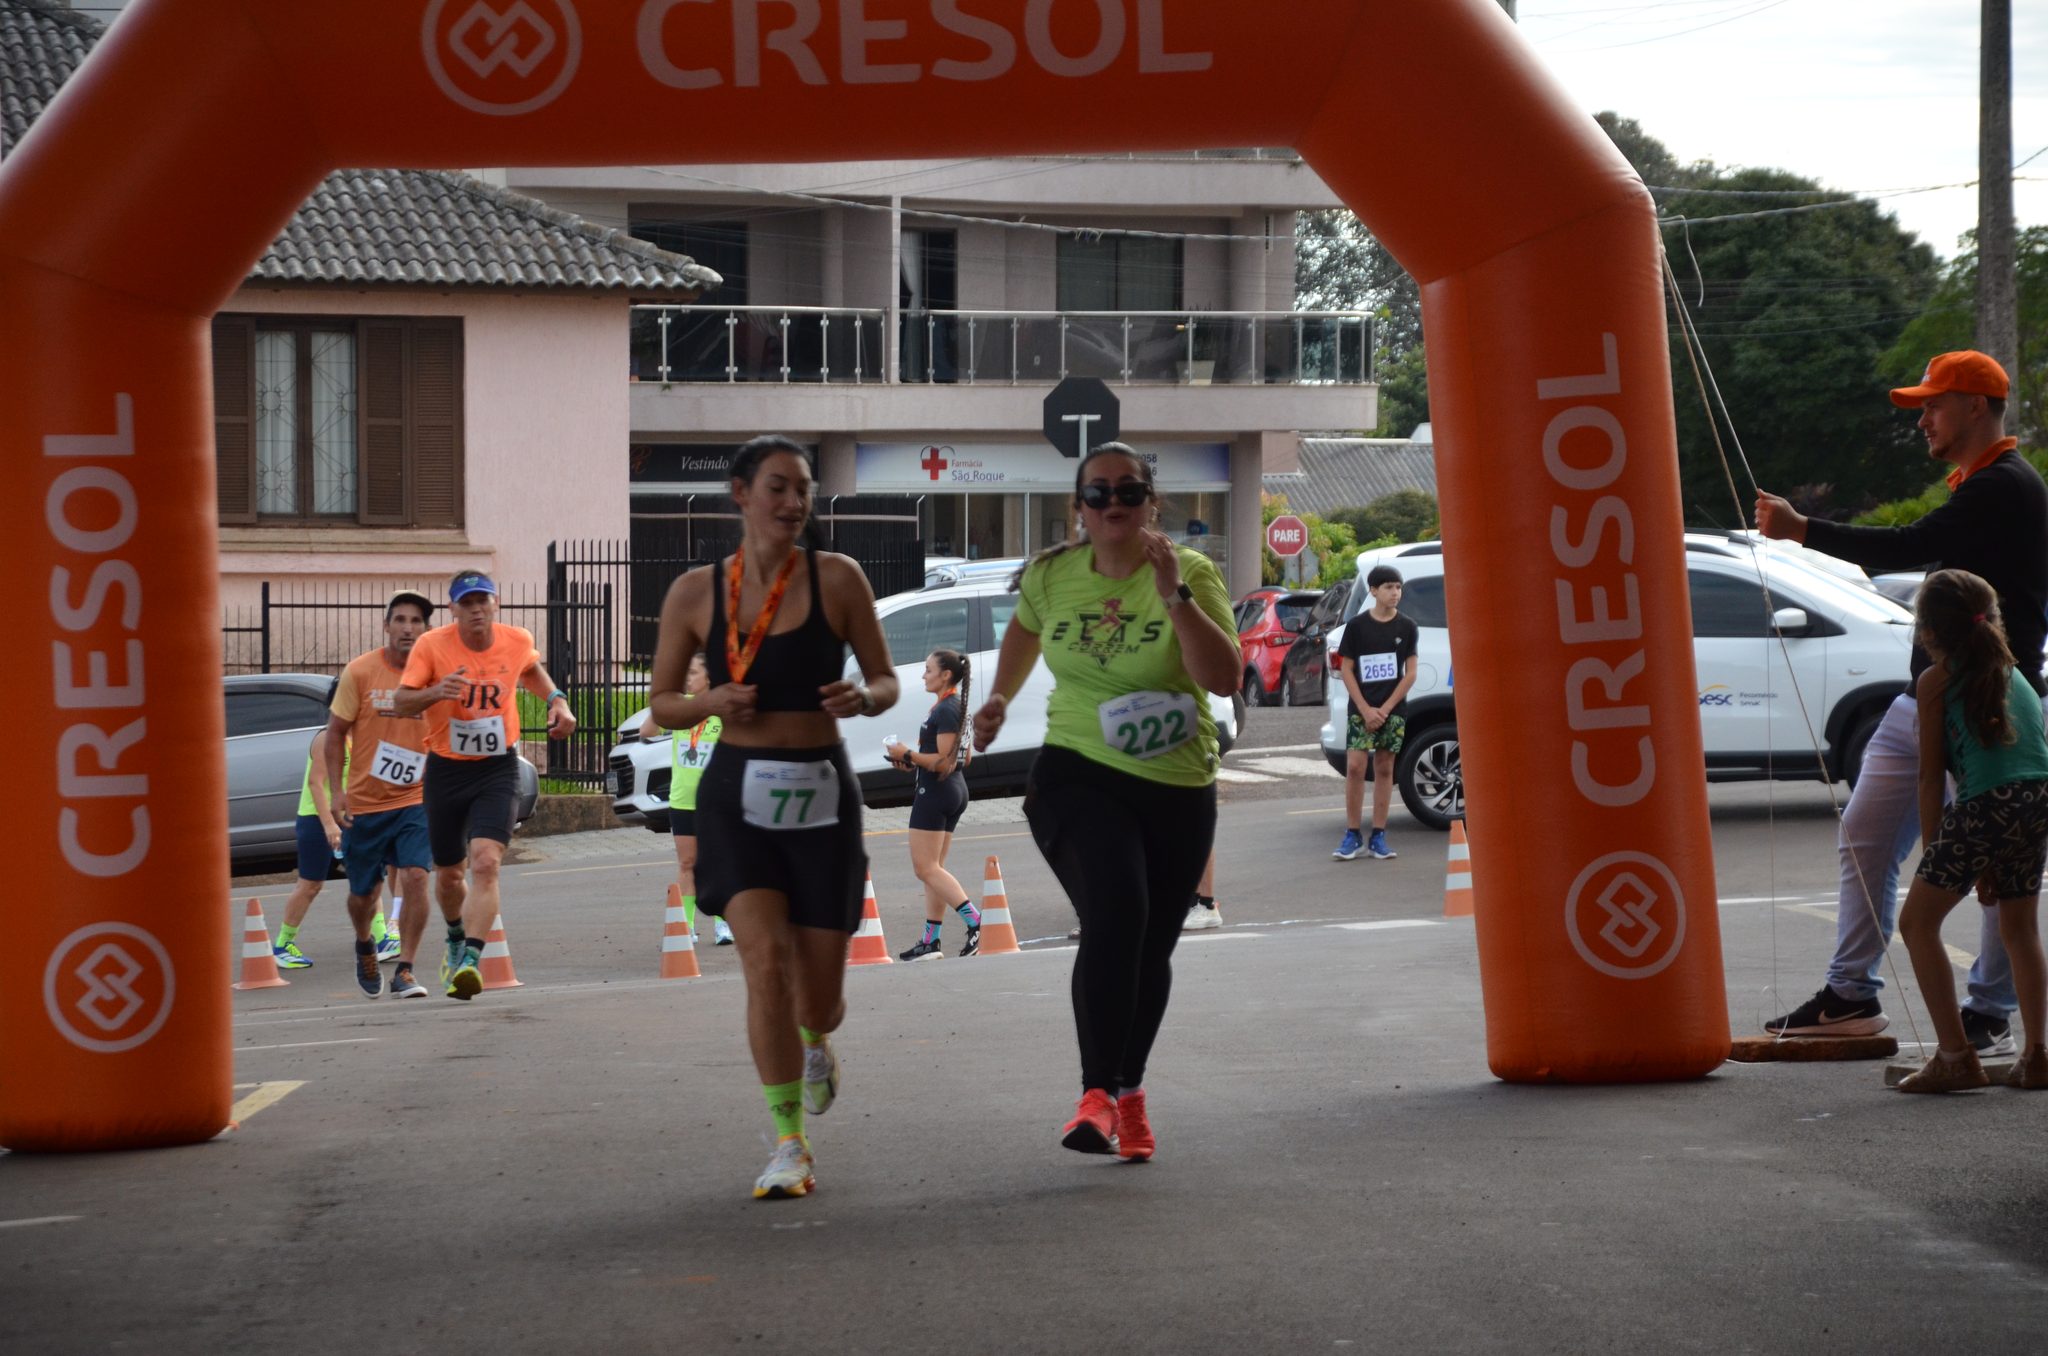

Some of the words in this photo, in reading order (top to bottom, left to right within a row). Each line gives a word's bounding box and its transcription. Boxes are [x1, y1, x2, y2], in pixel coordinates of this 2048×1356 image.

[635, 0, 1214, 90] CRESOL
[681, 456, 729, 470] Vestindo
[951, 459, 983, 468] Farmácia
[951, 470, 970, 481] São
[973, 471, 1005, 482] Roque
[1274, 529, 1301, 542] PARE
[1536, 331, 1656, 807] CRESOL
[42, 391, 152, 877] CRESOL
[1067, 642, 1141, 654] CORREM
[1364, 663, 1395, 679] 2655
[461, 683, 501, 710] JR
[456, 732, 498, 752] 719
[1118, 709, 1188, 756] 222
[379, 756, 416, 784] 705
[769, 788, 817, 824] 77
